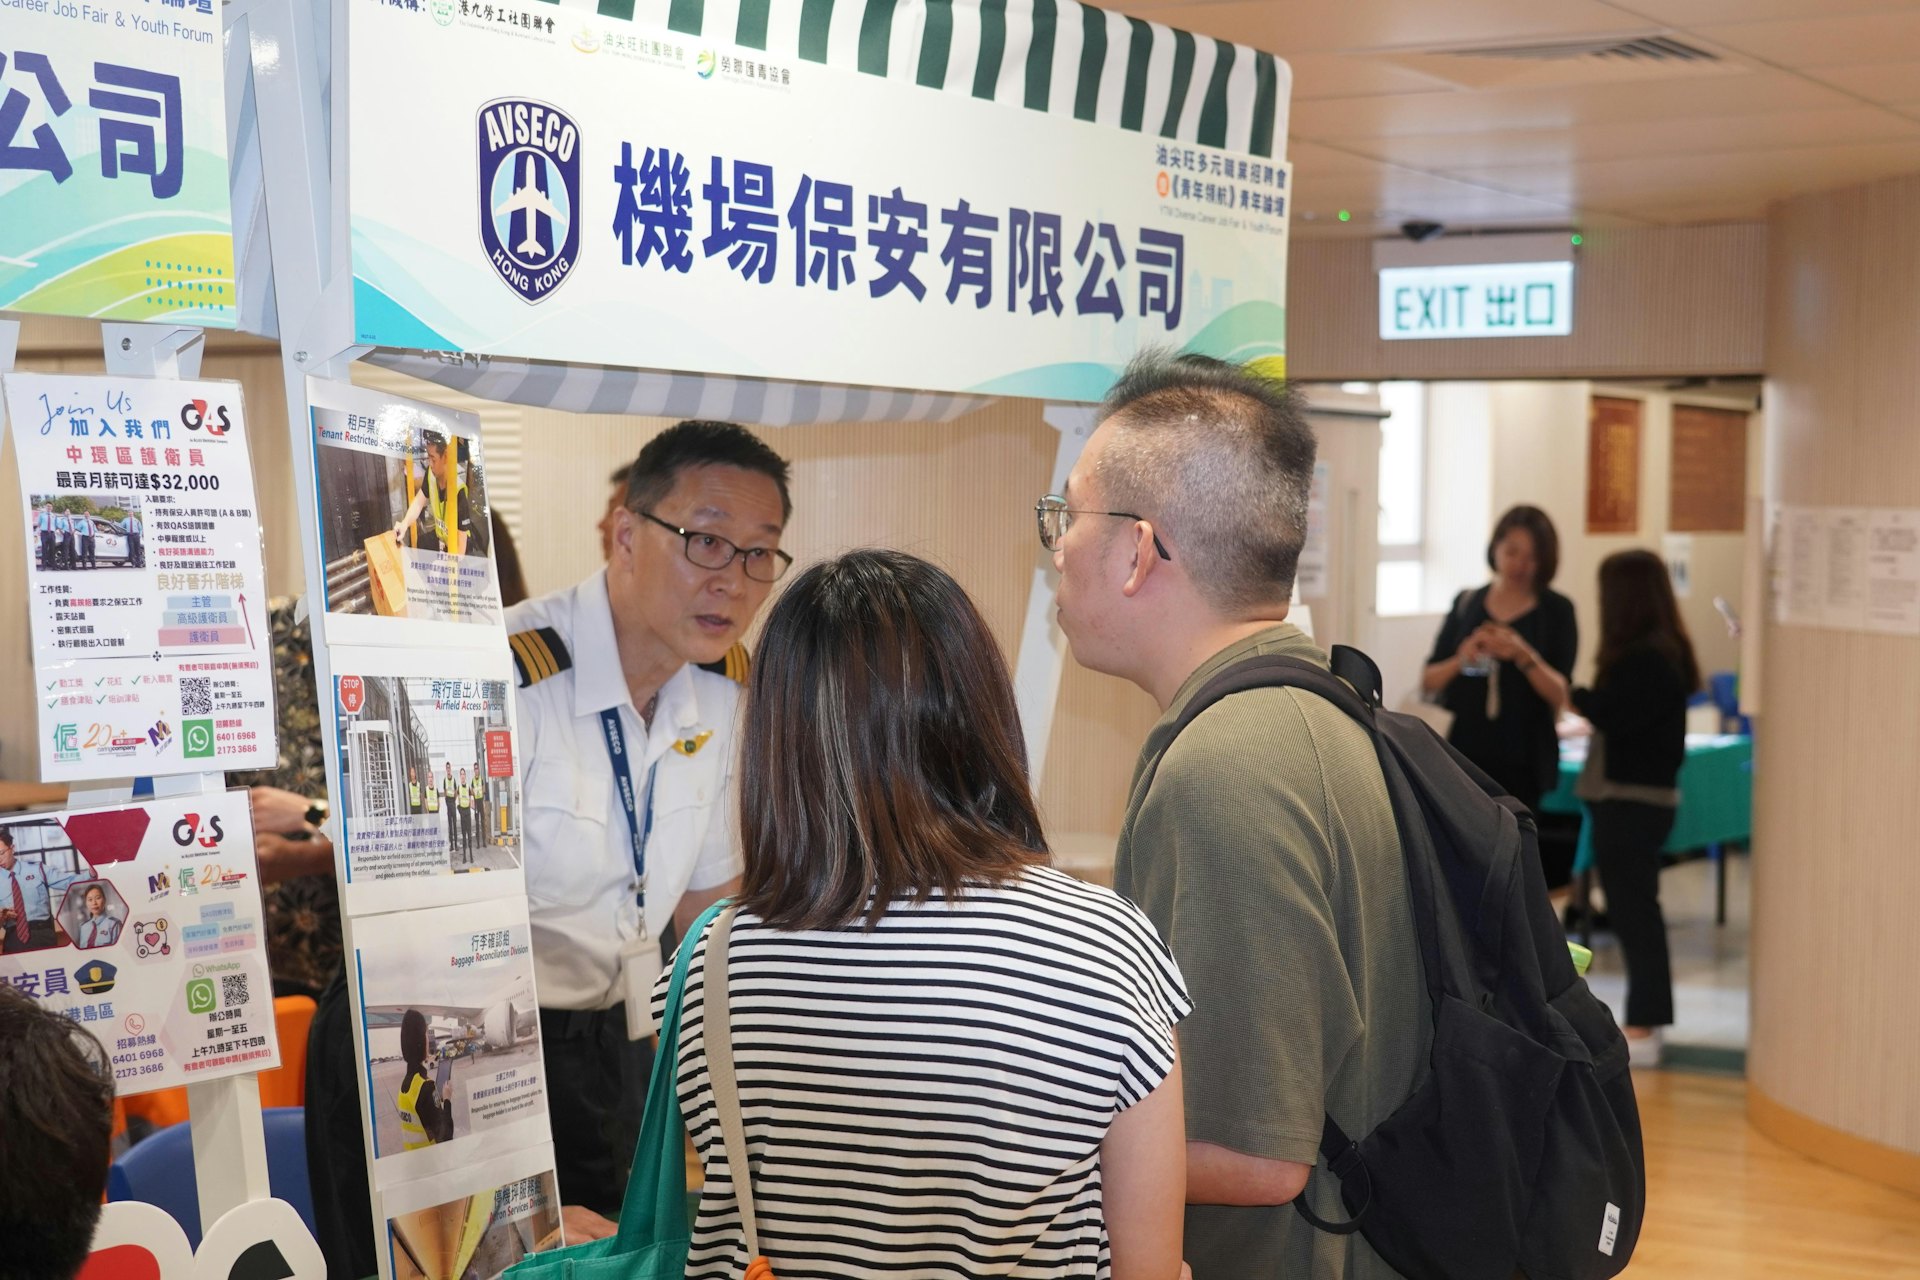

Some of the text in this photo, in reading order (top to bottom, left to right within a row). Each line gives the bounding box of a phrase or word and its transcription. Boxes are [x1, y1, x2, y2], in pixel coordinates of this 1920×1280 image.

[53, 1, 78, 19] Job
[83, 5, 109, 24] Fair
[115, 11, 125, 27] &
[131, 14, 169, 36] Youth
[174, 22, 213, 44] Forum
[484, 104, 576, 162] AVSECO
[612, 141, 1184, 331] 機場保安有限公司
[493, 249, 570, 292] HONG KONG
[1395, 283, 1554, 330] EXIT 出口
[38, 390, 132, 436] Join Us
[181, 399, 231, 436] G4S
[69, 417, 171, 440] 加入我們
[317, 426, 343, 440] Tenant
[66, 444, 206, 467] 中環區護衛員
[157, 573, 244, 590] 良好晉升階梯
[192, 596, 212, 608] 主管
[344, 679, 360, 689] STOP
[436, 700, 460, 710] Airfield
[461, 700, 482, 710] Access
[216, 731, 256, 741] 6401 6968
[607, 718, 622, 755] AVSECO
[217, 744, 257, 755] 2173 3686
[172, 812, 223, 848] G4S
[471, 930, 510, 952] 行李確認組
[206, 962, 241, 972] WhatsApp
[451, 944, 529, 968] Baggage Reconciliation Division
[0, 967, 71, 999] 安員
[208, 1008, 242, 1022] 辦公時間
[117, 1034, 157, 1050] 招募熱線
[207, 1023, 248, 1039] 星期一至五
[113, 1048, 164, 1065] 6401 6968
[192, 1036, 266, 1058] 上午九時至下午四時
[116, 1063, 164, 1079] 2173 3686
[507, 1203, 529, 1217] Services
